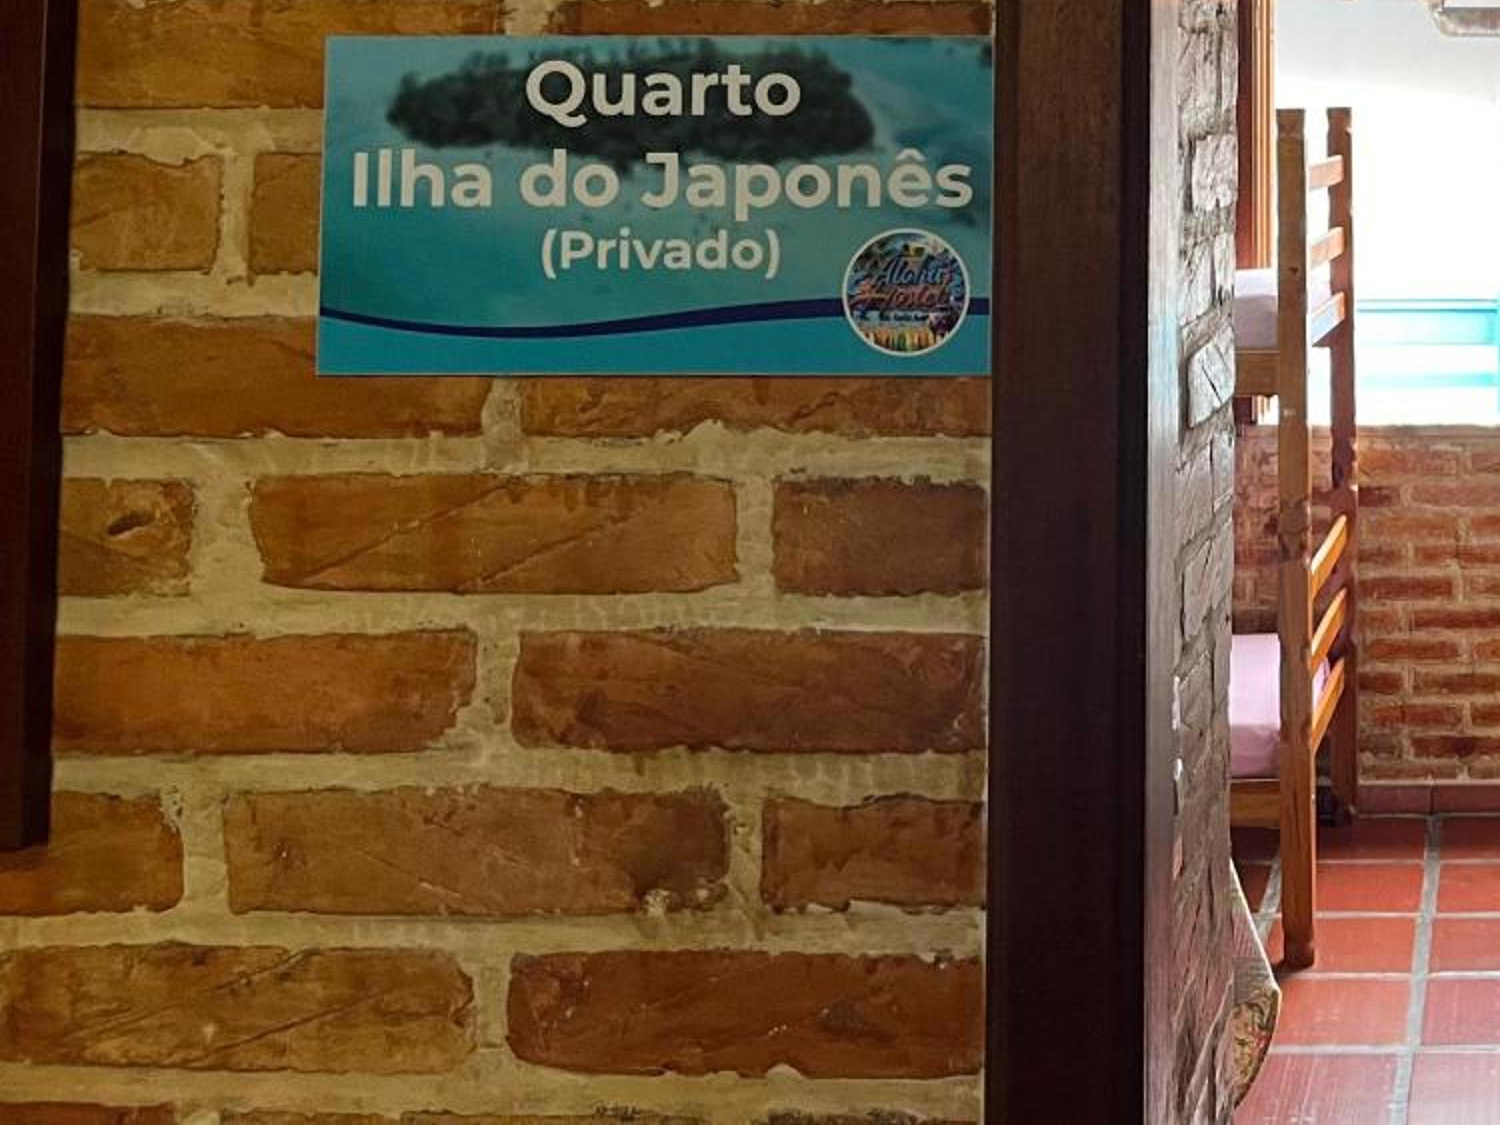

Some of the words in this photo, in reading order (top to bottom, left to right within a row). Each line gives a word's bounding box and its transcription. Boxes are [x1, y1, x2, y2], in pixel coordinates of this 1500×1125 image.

[526, 60, 801, 127] Quarto
[353, 148, 492, 207] Ilha
[520, 148, 619, 207] do
[641, 148, 973, 222] Japonês
[541, 228, 781, 279] (Privado)
